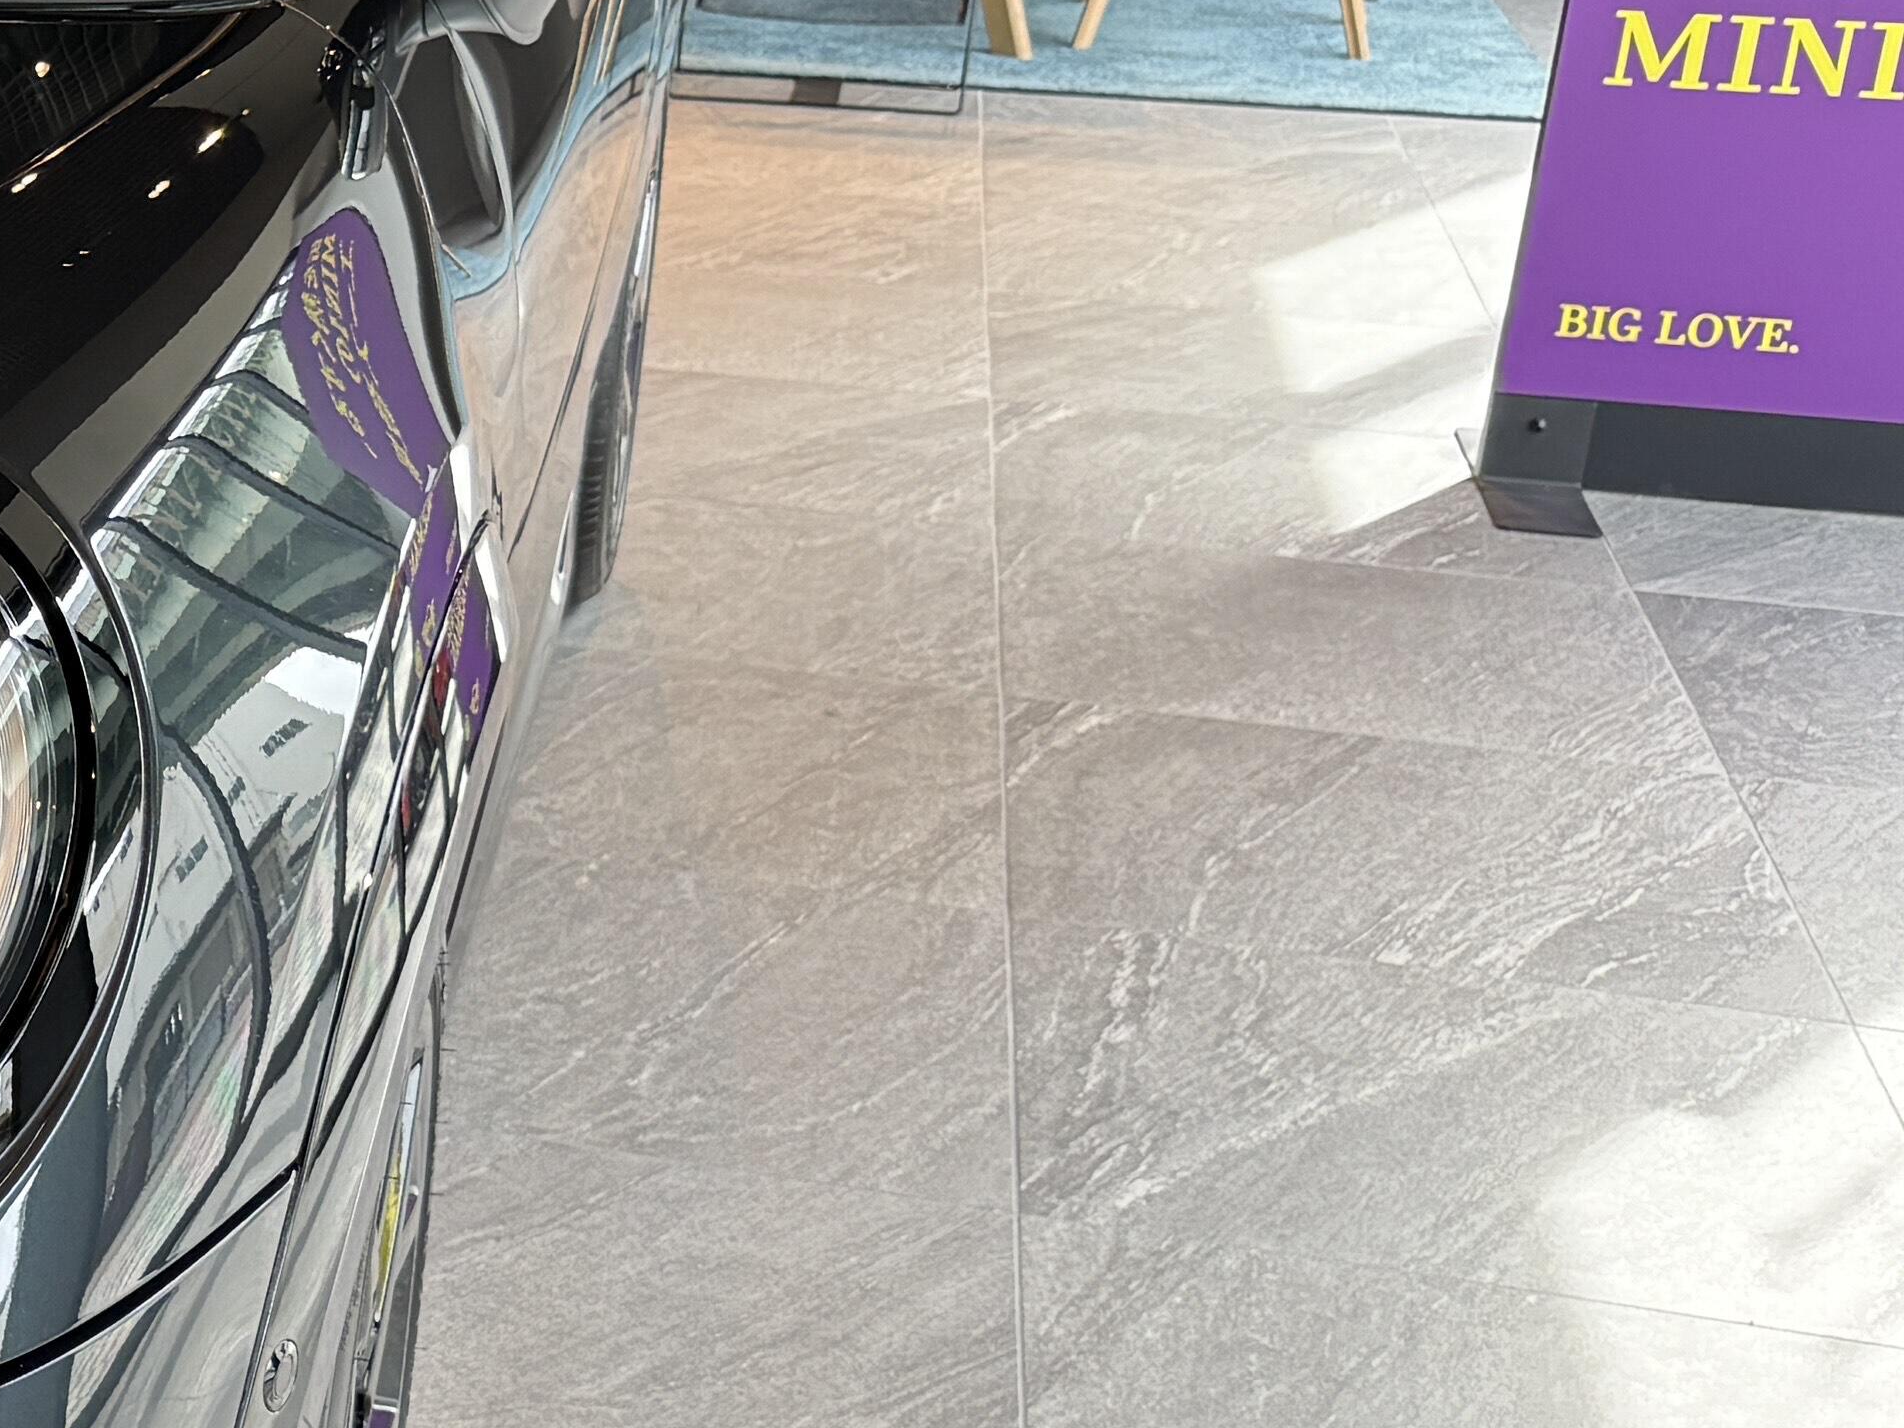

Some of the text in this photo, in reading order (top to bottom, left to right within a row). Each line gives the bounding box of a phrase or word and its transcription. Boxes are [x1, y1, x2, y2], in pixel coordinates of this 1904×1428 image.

[1603, 9, 1904, 101] MINI
[1555, 303, 1800, 355] BIG LOVE.
